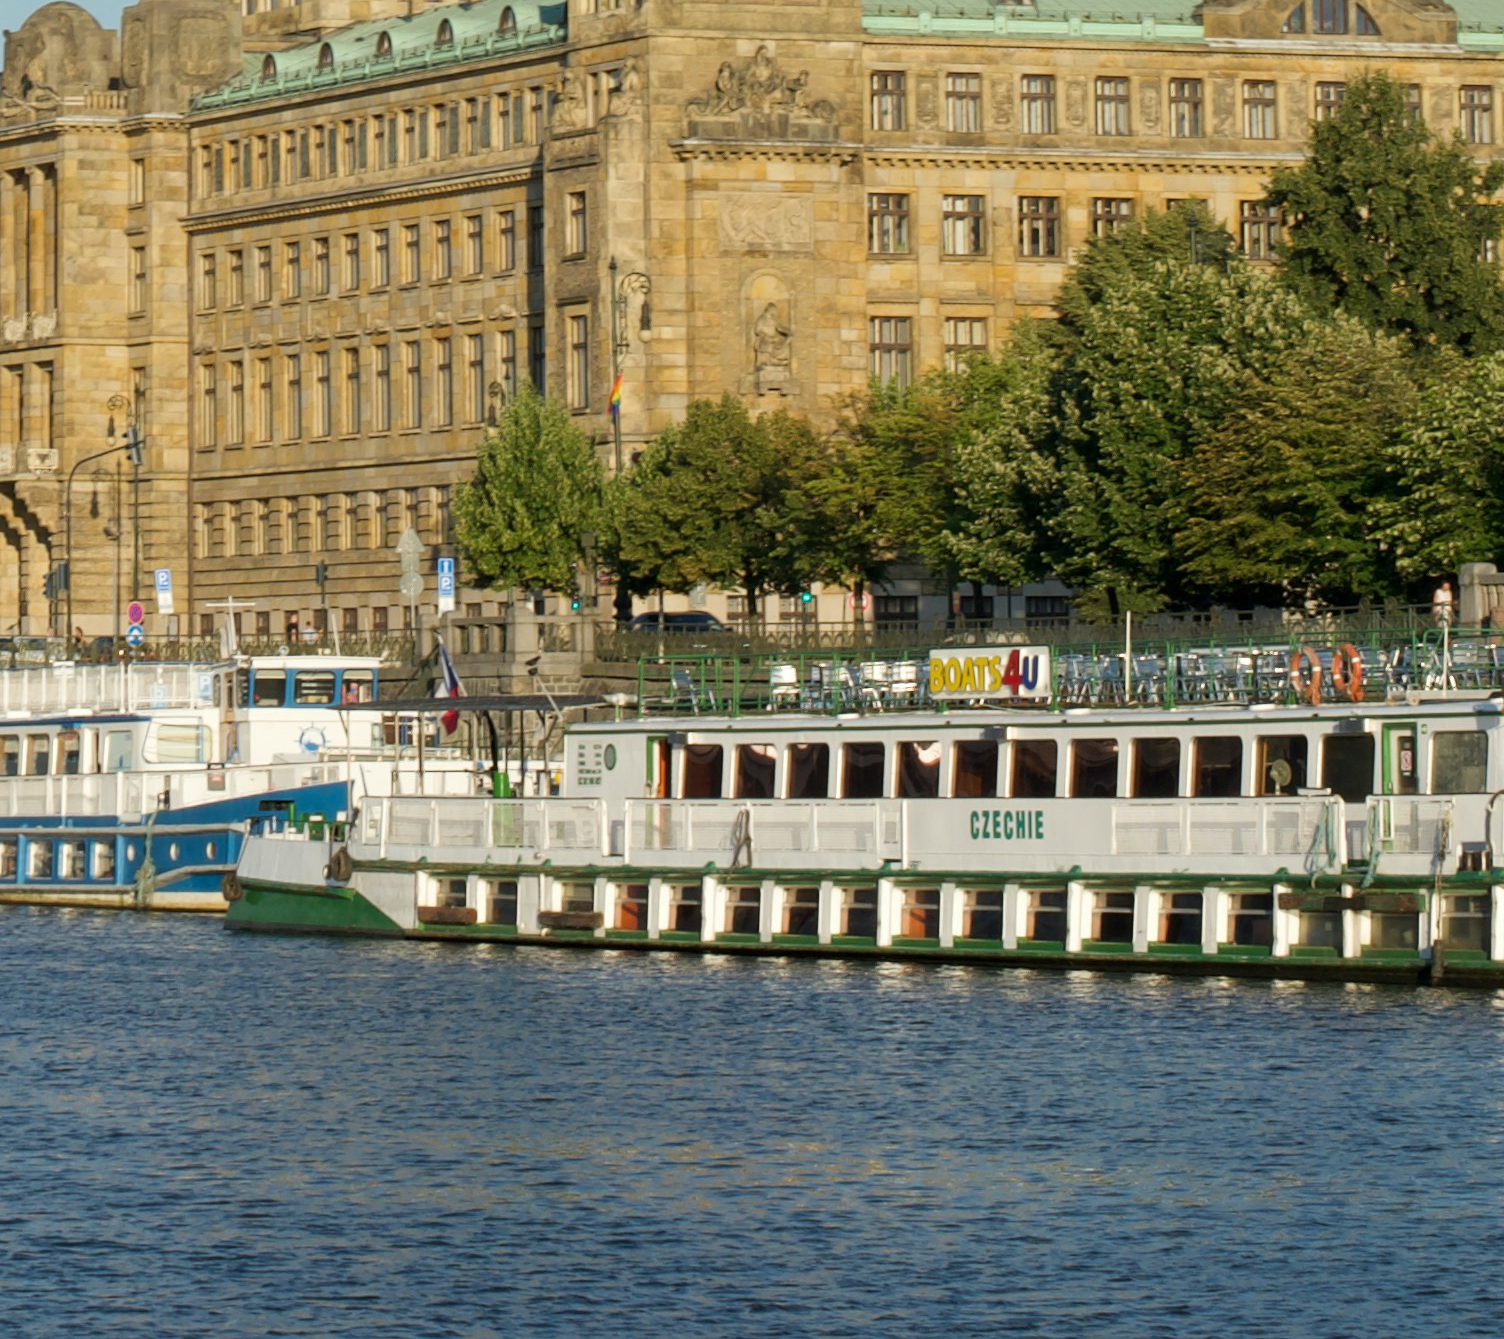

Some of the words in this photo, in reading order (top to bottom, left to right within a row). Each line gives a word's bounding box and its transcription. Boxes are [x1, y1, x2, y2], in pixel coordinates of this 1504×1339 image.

[441, 577, 451, 590] P
[930, 649, 1039, 696] BOATS4U
[970, 810, 1044, 840] CZECHIE
